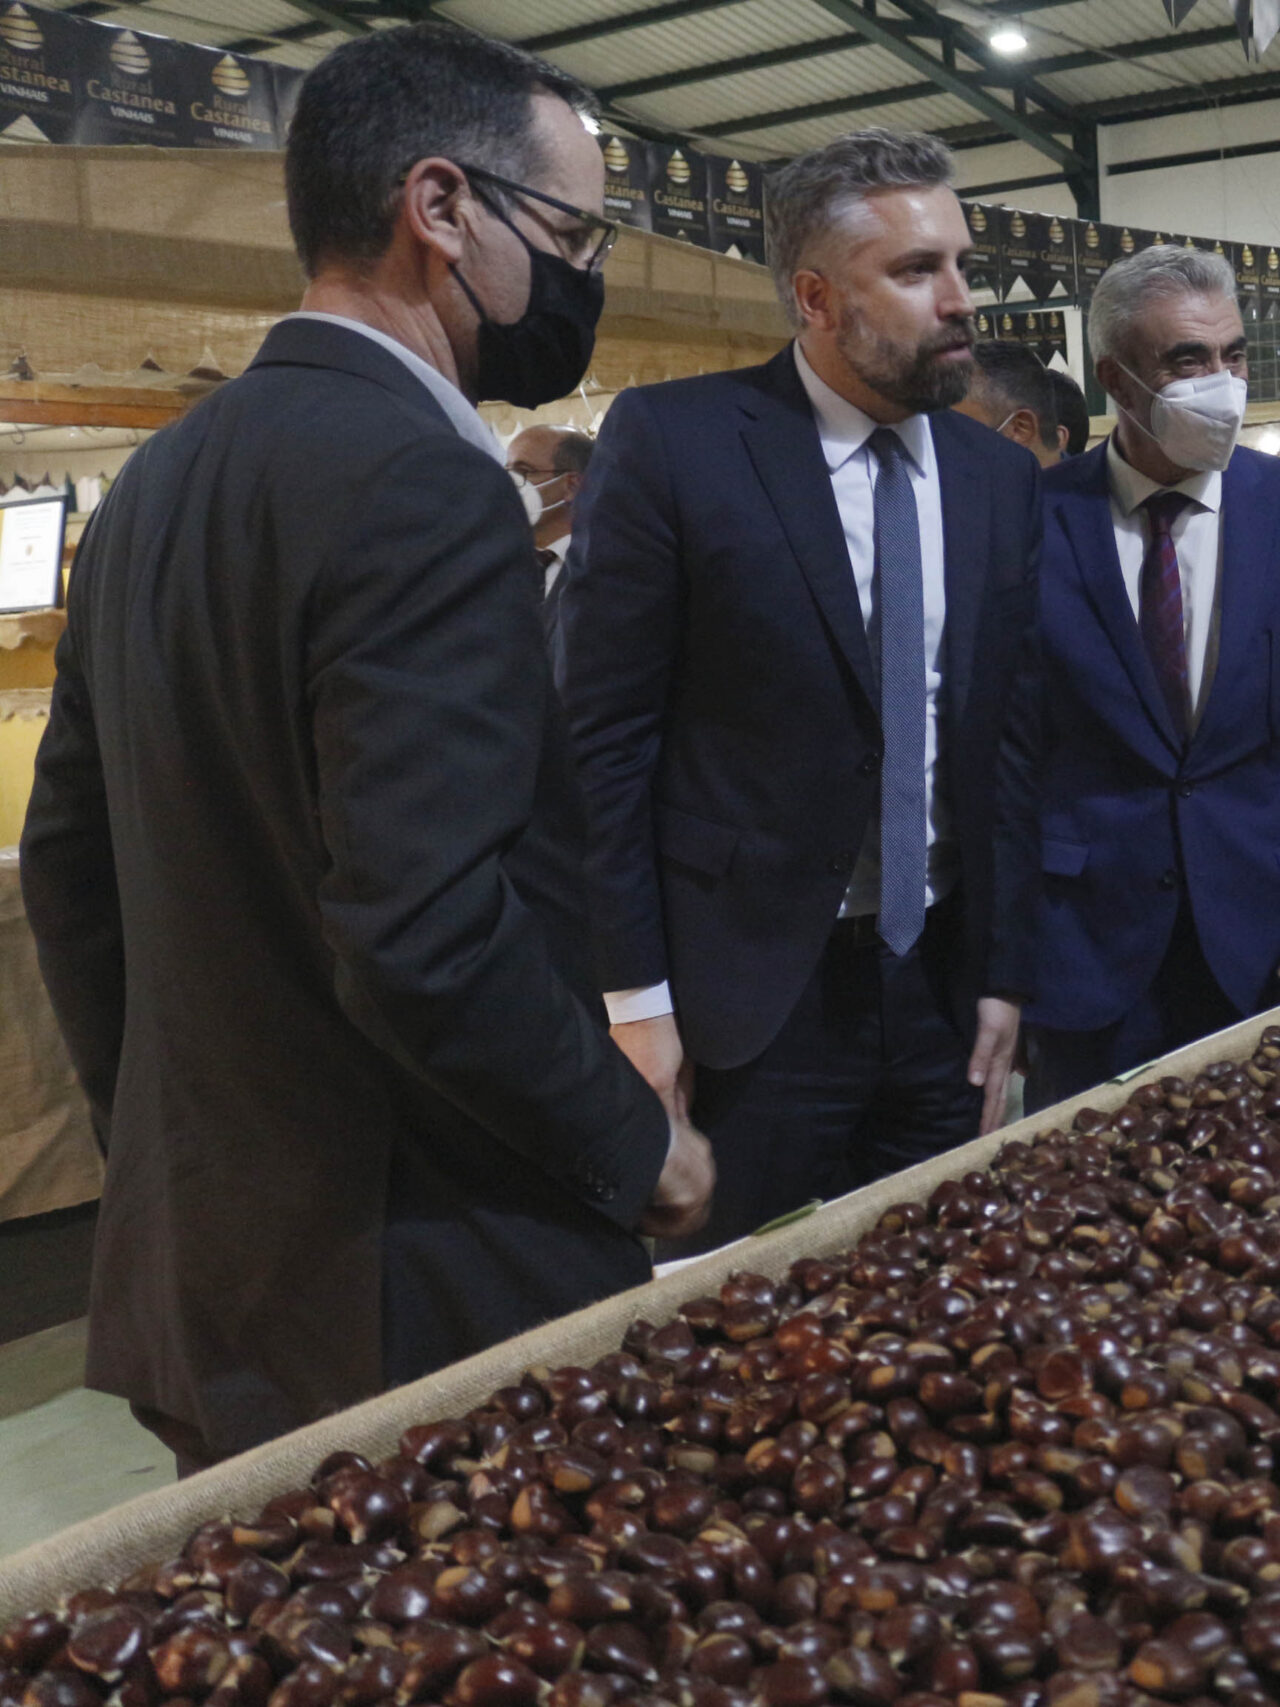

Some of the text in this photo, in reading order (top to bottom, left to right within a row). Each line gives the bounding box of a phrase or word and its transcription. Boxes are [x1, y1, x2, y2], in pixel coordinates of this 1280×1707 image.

[0, 65, 72, 94] stanea
[87, 79, 177, 115] Castanea
[110, 104, 155, 124] VINHAIS
[190, 101, 273, 135] Castanea
[213, 126, 255, 144] VINHAIS
[604, 184, 646, 201] stanea
[654, 190, 705, 212] Castanea
[713, 198, 762, 219] Castanea
